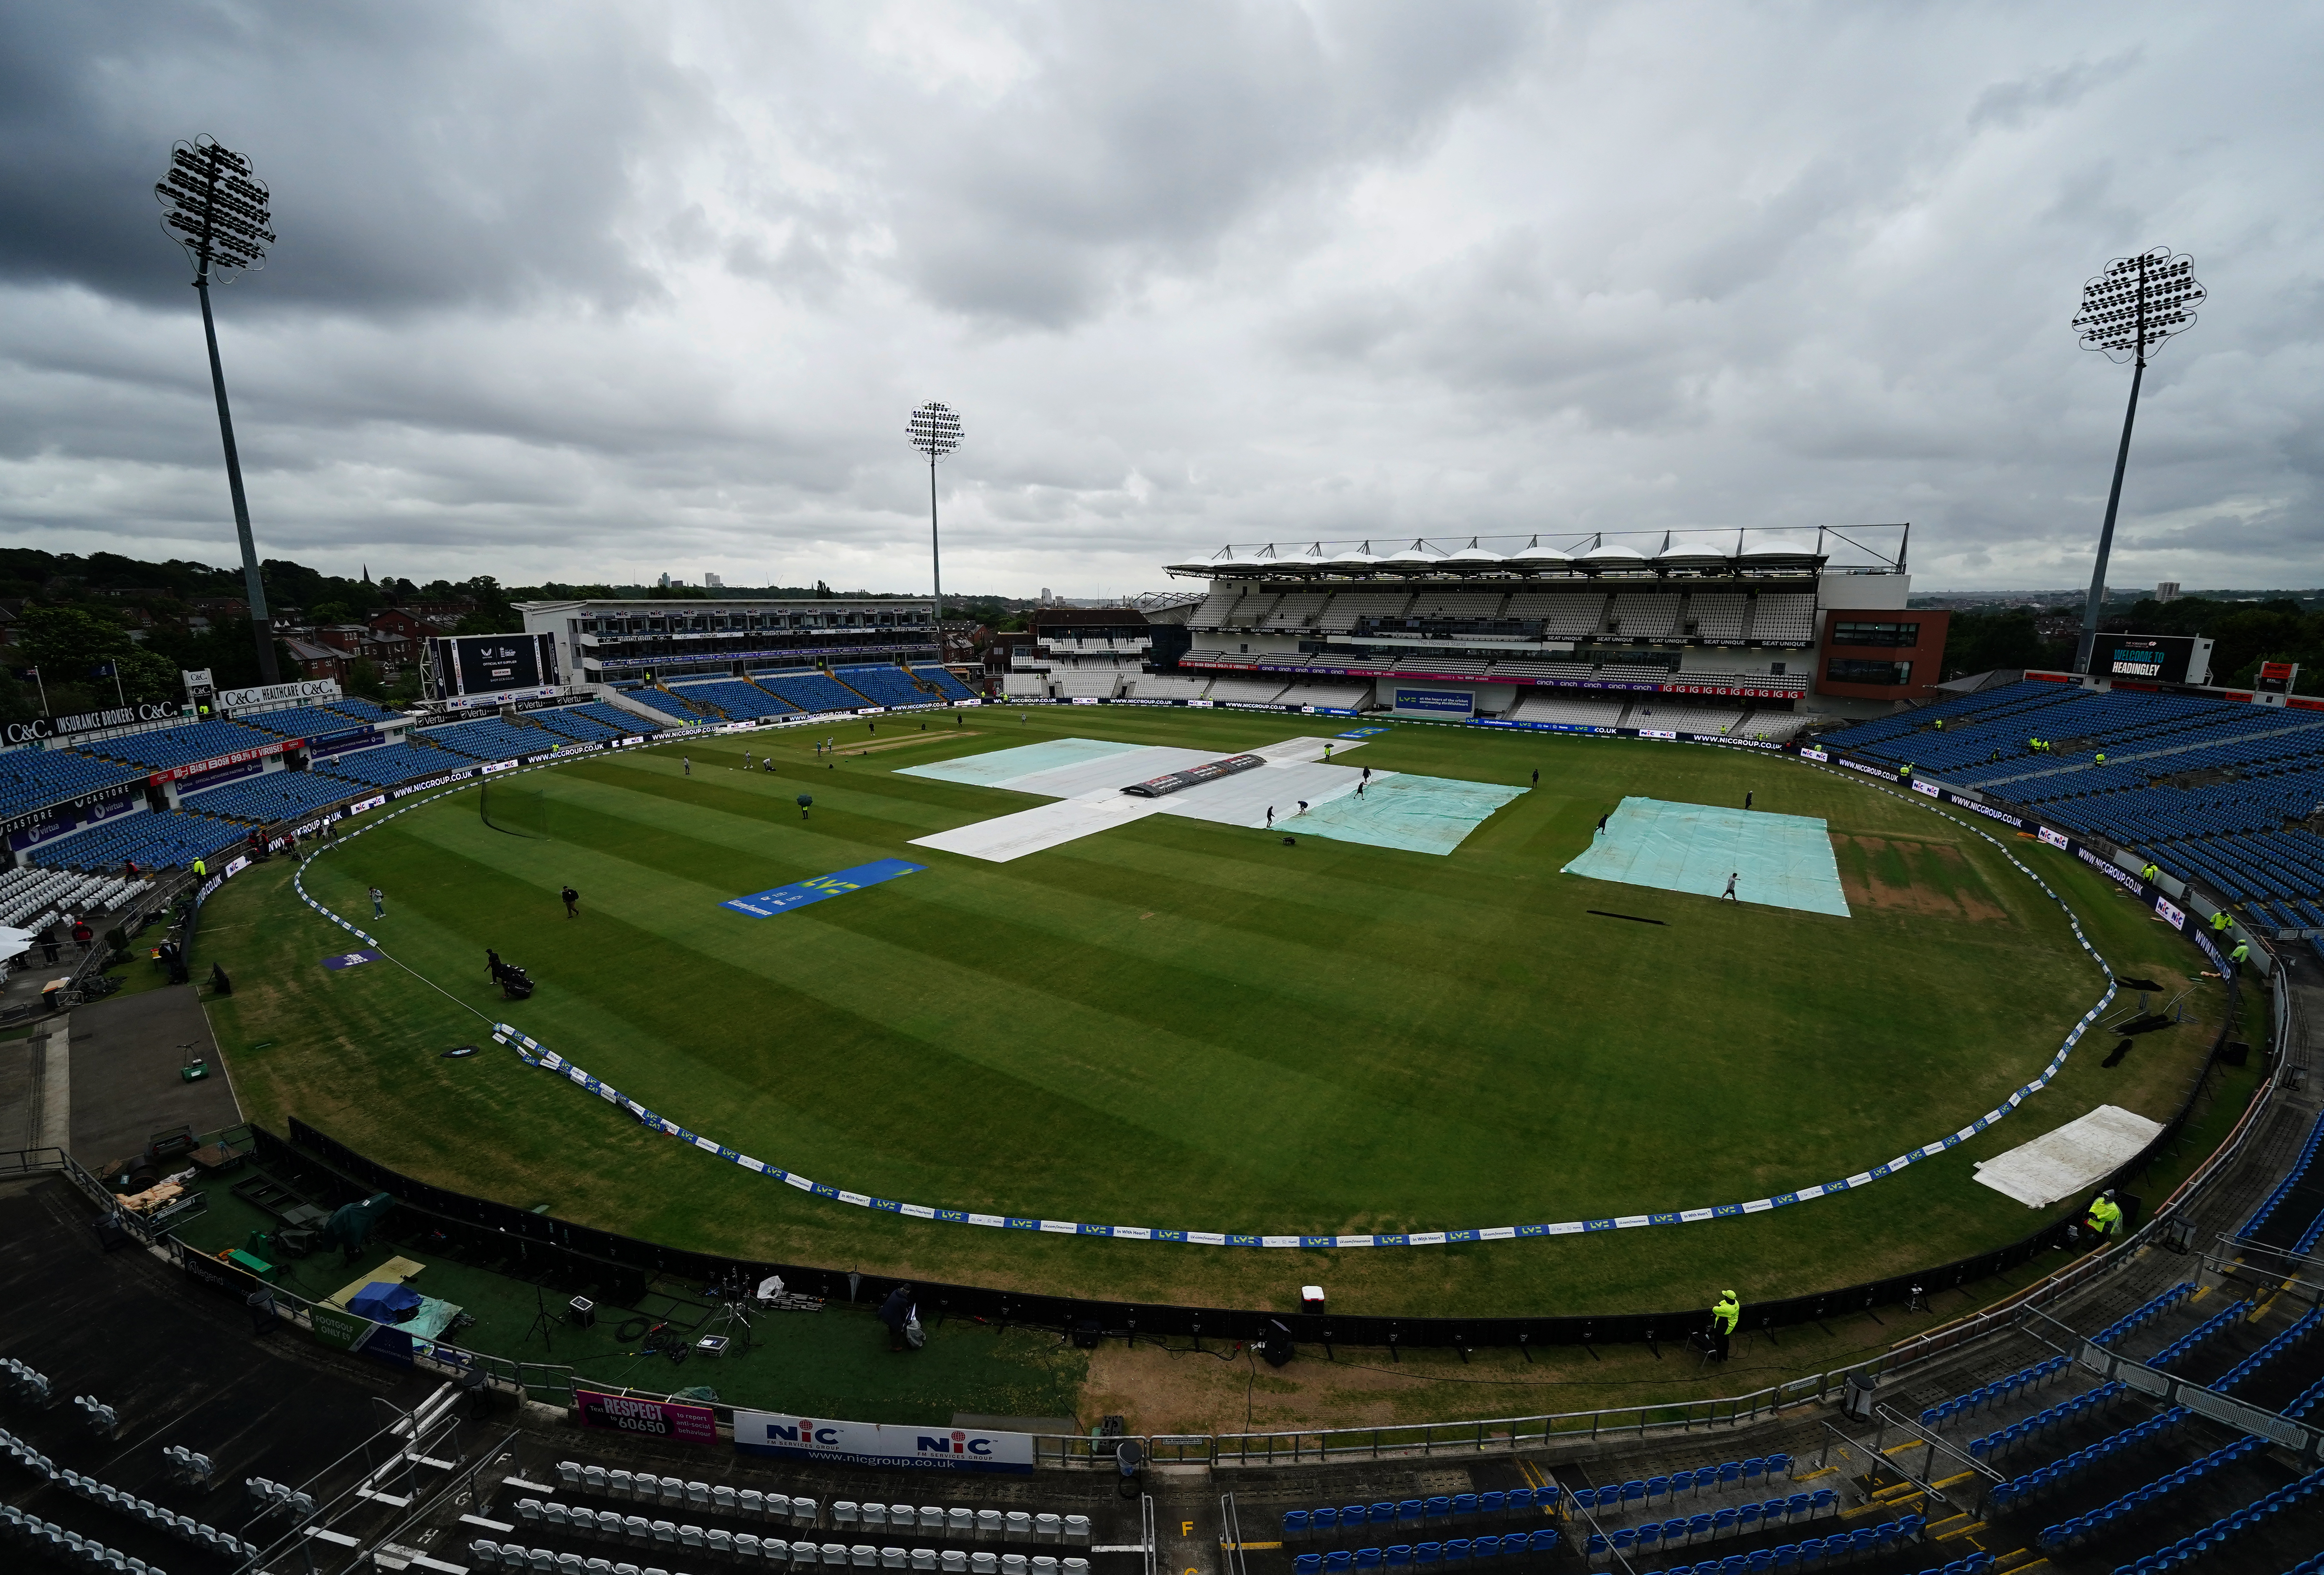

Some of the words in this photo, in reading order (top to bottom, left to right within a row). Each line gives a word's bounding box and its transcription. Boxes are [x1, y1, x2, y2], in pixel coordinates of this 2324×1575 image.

[2114, 649, 2152, 663] WELCOME
[2153, 651, 2165, 664] TO
[2112, 662, 2160, 677] HEADINGLEY
[262, 685, 299, 700] HEALTHCARE
[562, 695, 581, 705] Vertu
[523, 699, 543, 709] Vertu
[892, 702, 947, 711] WWW.NICGROUP.CO.UK
[1225, 702, 1286, 710] WWW.NICGROUP.CO.UK
[56, 712, 101, 734] INSURANCE
[101, 707, 135, 726] BROKERS
[424, 715, 445, 725] Vertu
[467, 708, 487, 718] Vertu
[189, 762, 207, 774] BASH
[208, 757, 229, 769] BOSH
[231, 752, 250, 763] 99.9%
[251, 750, 257, 758] OF
[258, 743, 283, 757] VIRUSES
[528, 743, 604, 763] WWW.NICGROUP.CO.UK
[1839, 758, 1898, 782] WWW.NICGROUP.CO.UK
[394, 770, 473, 799] WWW.NICGROUP.CO.UK
[87, 785, 129, 804] CASTORE
[105, 802, 124, 812] virtua
[1951, 794, 2022, 827] WWW.NICGROUP.CO.UK
[7, 809, 53, 832] CASTORE
[40, 823, 59, 835] virtua
[2078, 847, 2143, 896] WWW.NICGROUP.CO.UK
[316, 1315, 353, 1333] FOOTGOLF
[321, 1326, 340, 1338] ONLY
[342, 1332, 351, 1341] £9
[369, 1346, 411, 1361] LEEDSGOLFCENTRE.COM
[603, 1397, 663, 1421] RESPECT
[619, 1417, 666, 1434] 60650
[676, 1420, 711, 1430] anti-social
[678, 1427, 711, 1438] behaviour
[808, 1451, 955, 1468] www.nicgroup.co.uk
[1182, 1521, 1194, 1537] F
